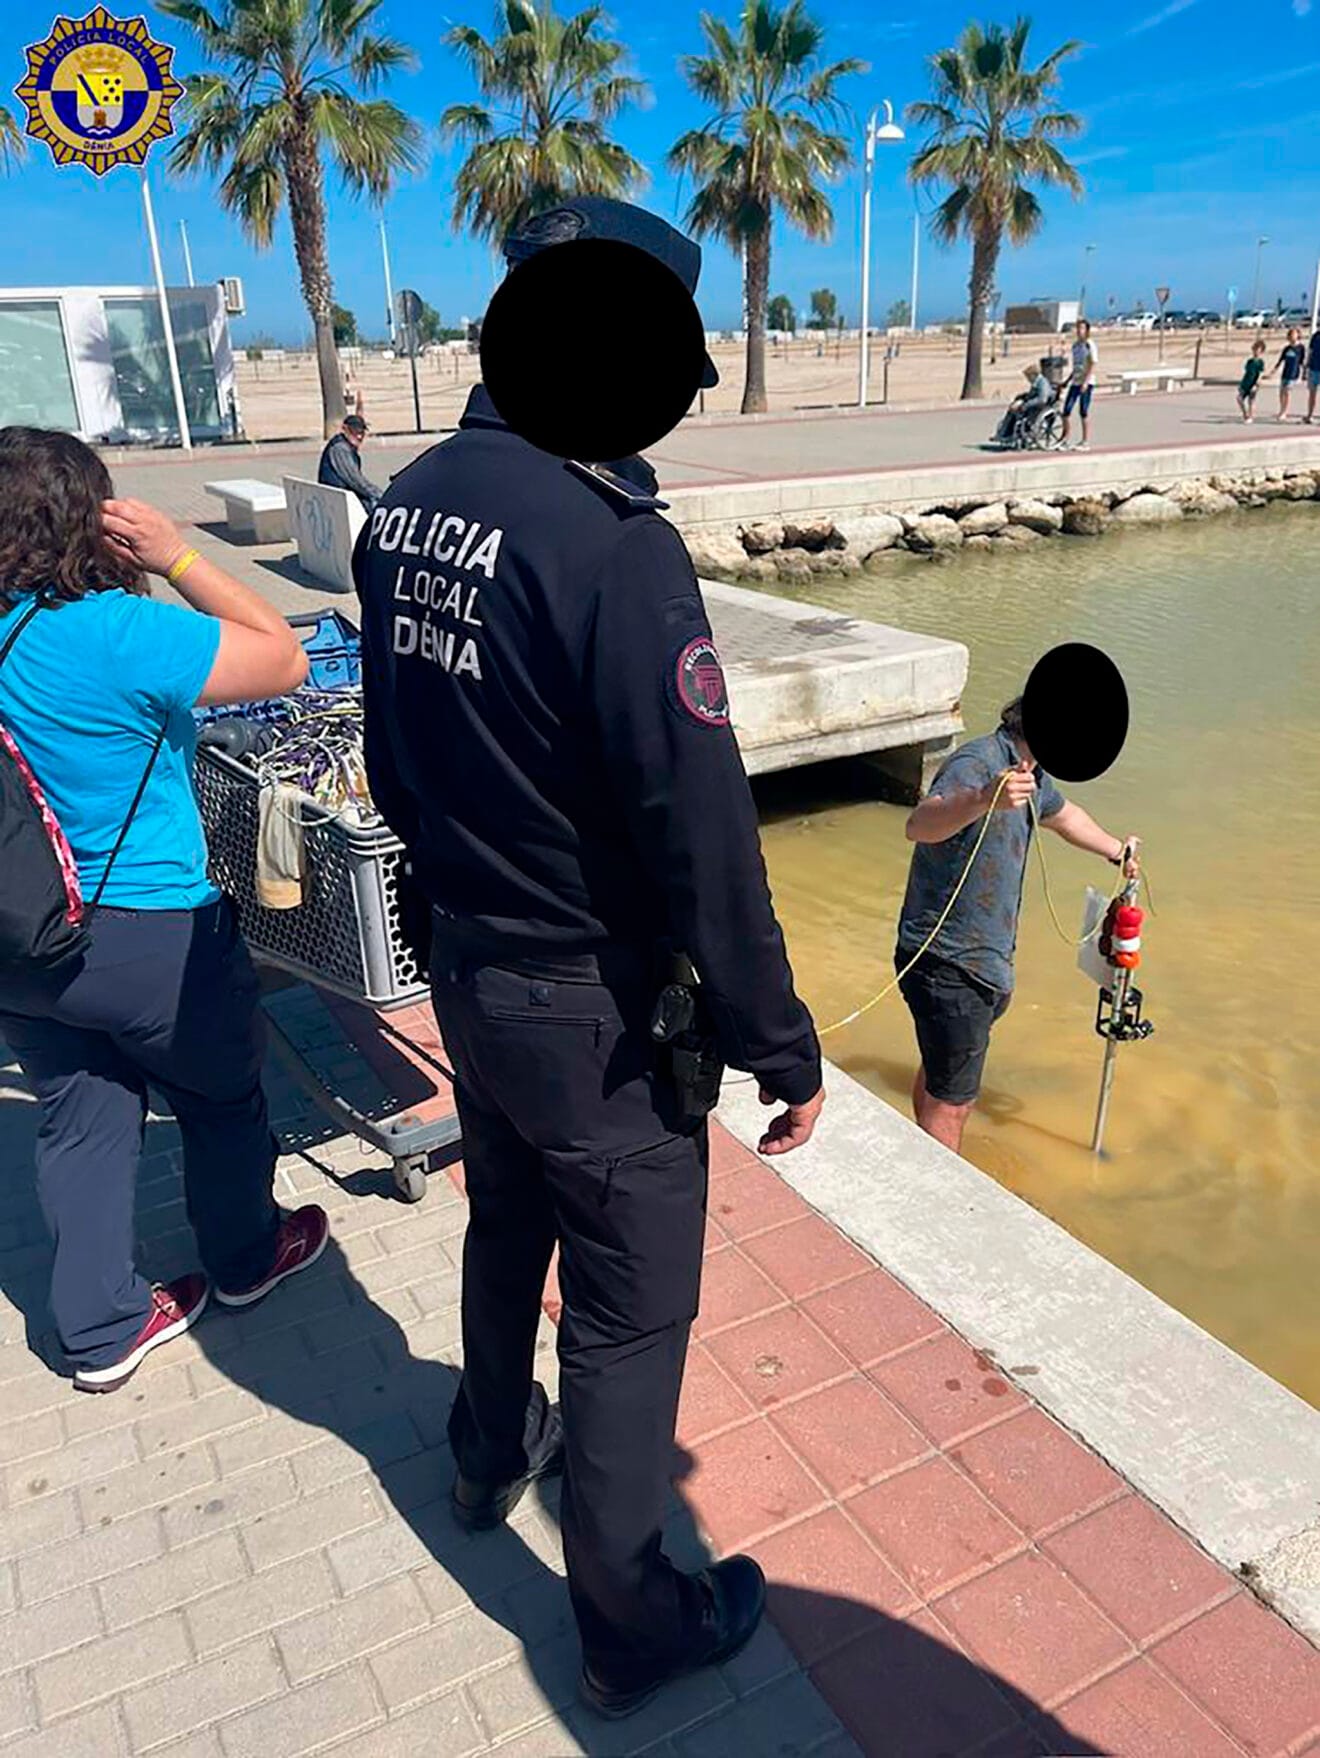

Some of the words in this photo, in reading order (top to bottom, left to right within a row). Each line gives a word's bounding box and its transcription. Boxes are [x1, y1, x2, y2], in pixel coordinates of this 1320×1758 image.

[367, 507, 503, 578] POLICIA
[394, 566, 482, 626] LOCAL
[393, 611, 483, 680] DÉNIA
